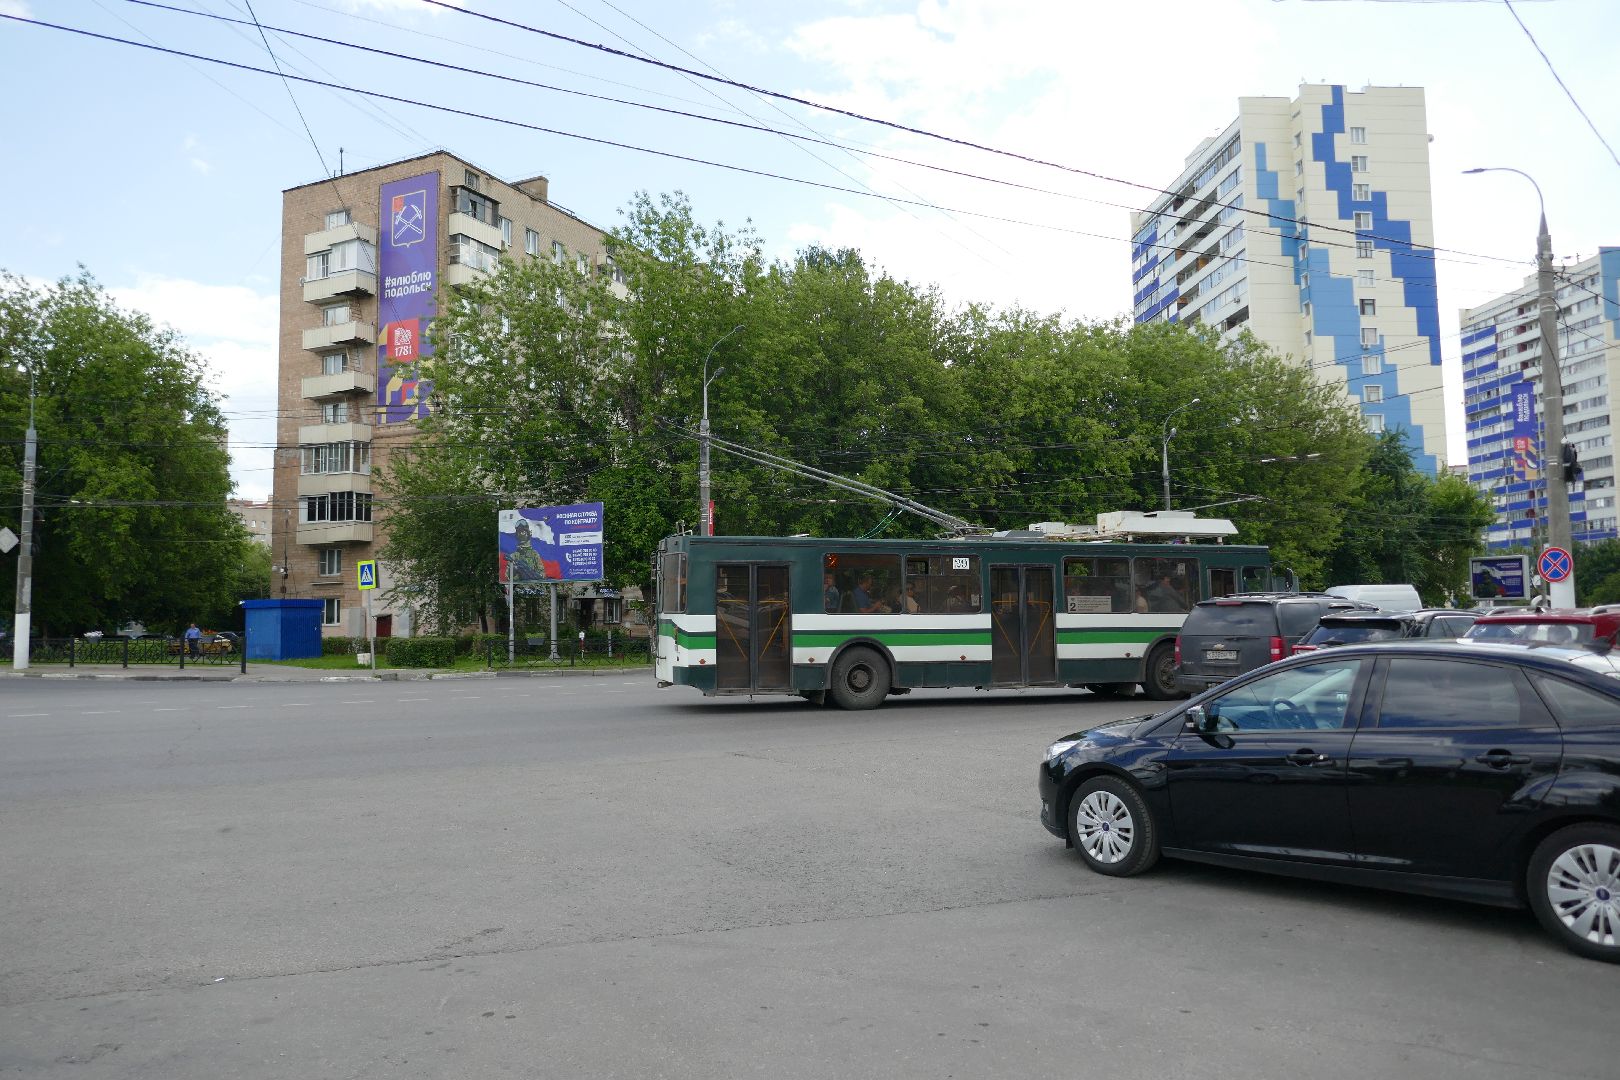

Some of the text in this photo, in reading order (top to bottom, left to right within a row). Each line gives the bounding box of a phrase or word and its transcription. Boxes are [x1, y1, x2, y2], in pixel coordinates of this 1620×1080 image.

[385, 271, 431, 288] #ялюблю
[395, 345, 412, 357] 1781
[1069, 602, 1077, 611] 2
